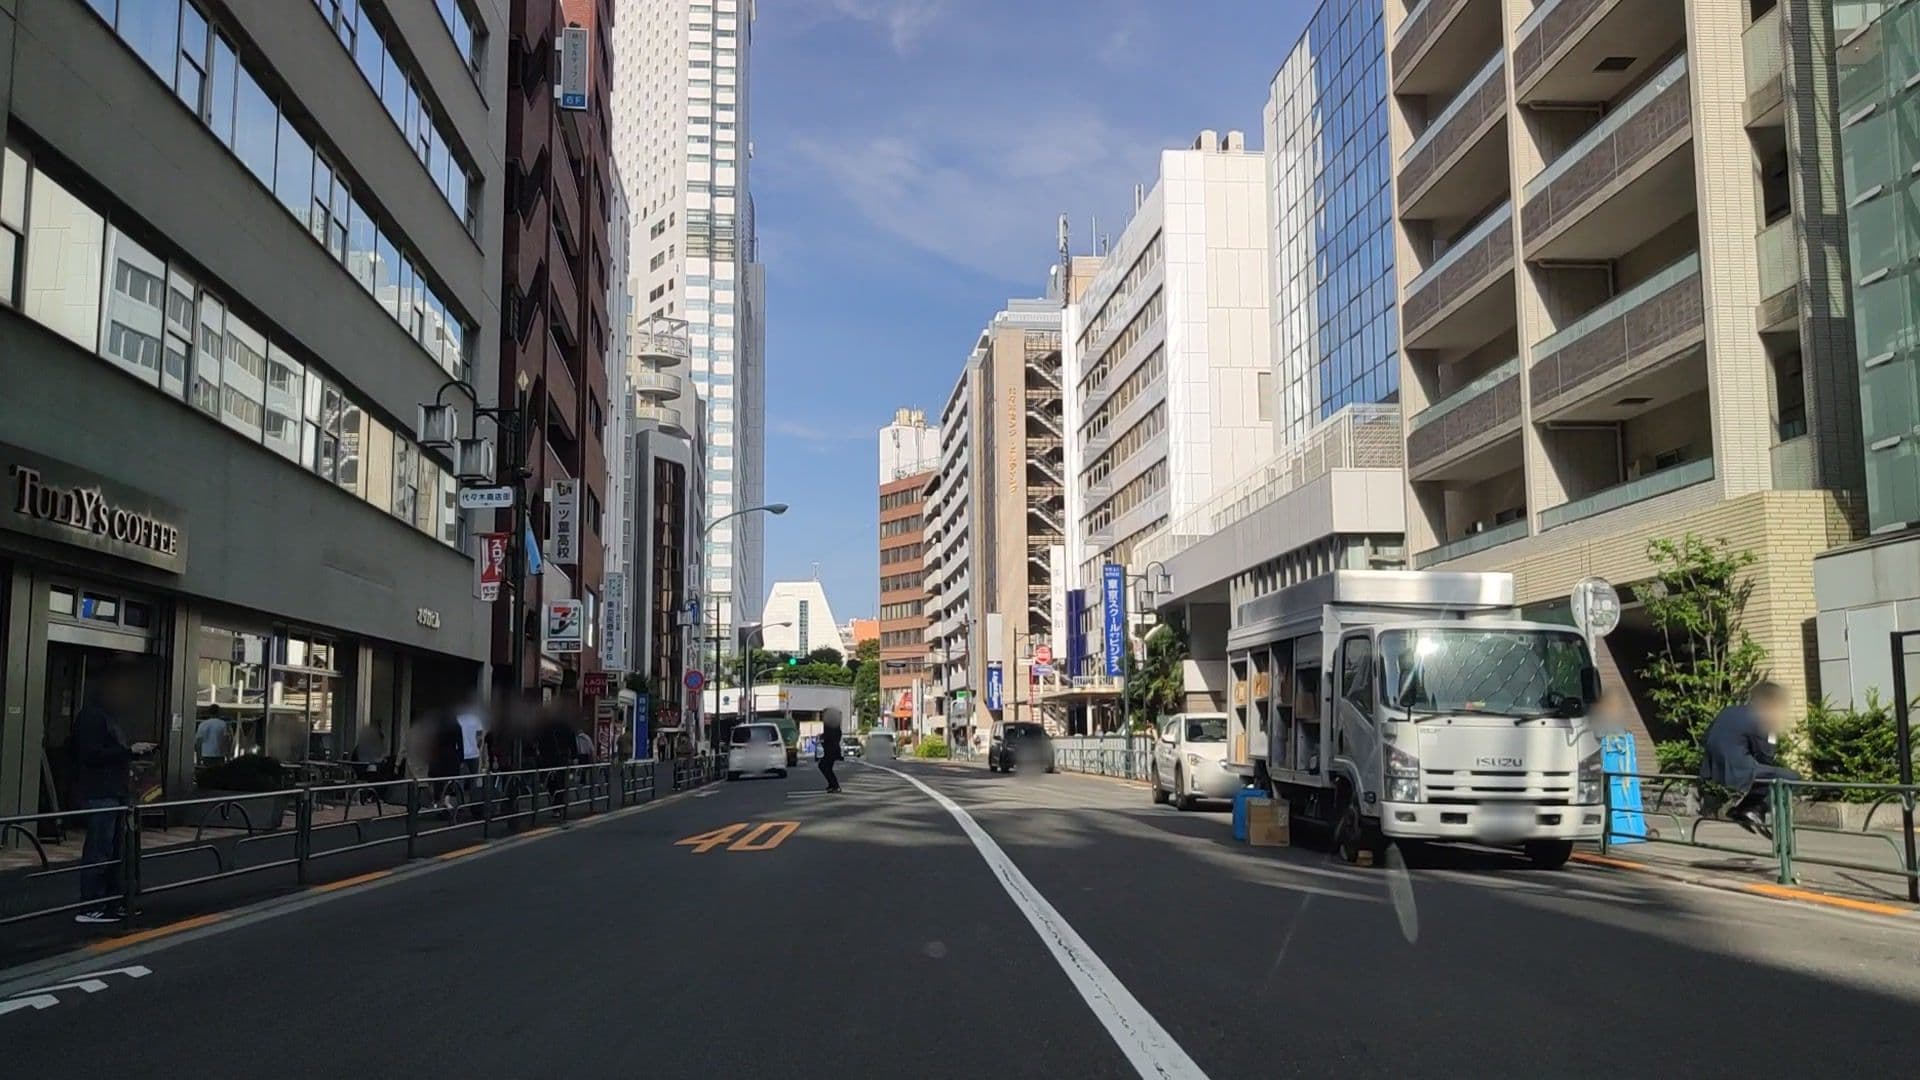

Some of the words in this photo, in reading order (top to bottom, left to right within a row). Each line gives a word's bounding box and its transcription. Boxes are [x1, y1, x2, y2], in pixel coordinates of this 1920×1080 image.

[566, 95, 583, 105] 6F
[462, 492, 511, 501] 代々木商店街
[111, 508, 178, 555] COFFEE
[491, 539, 503, 577] スロット
[1475, 756, 1523, 768] ISUZU
[673, 821, 801, 854] 40
